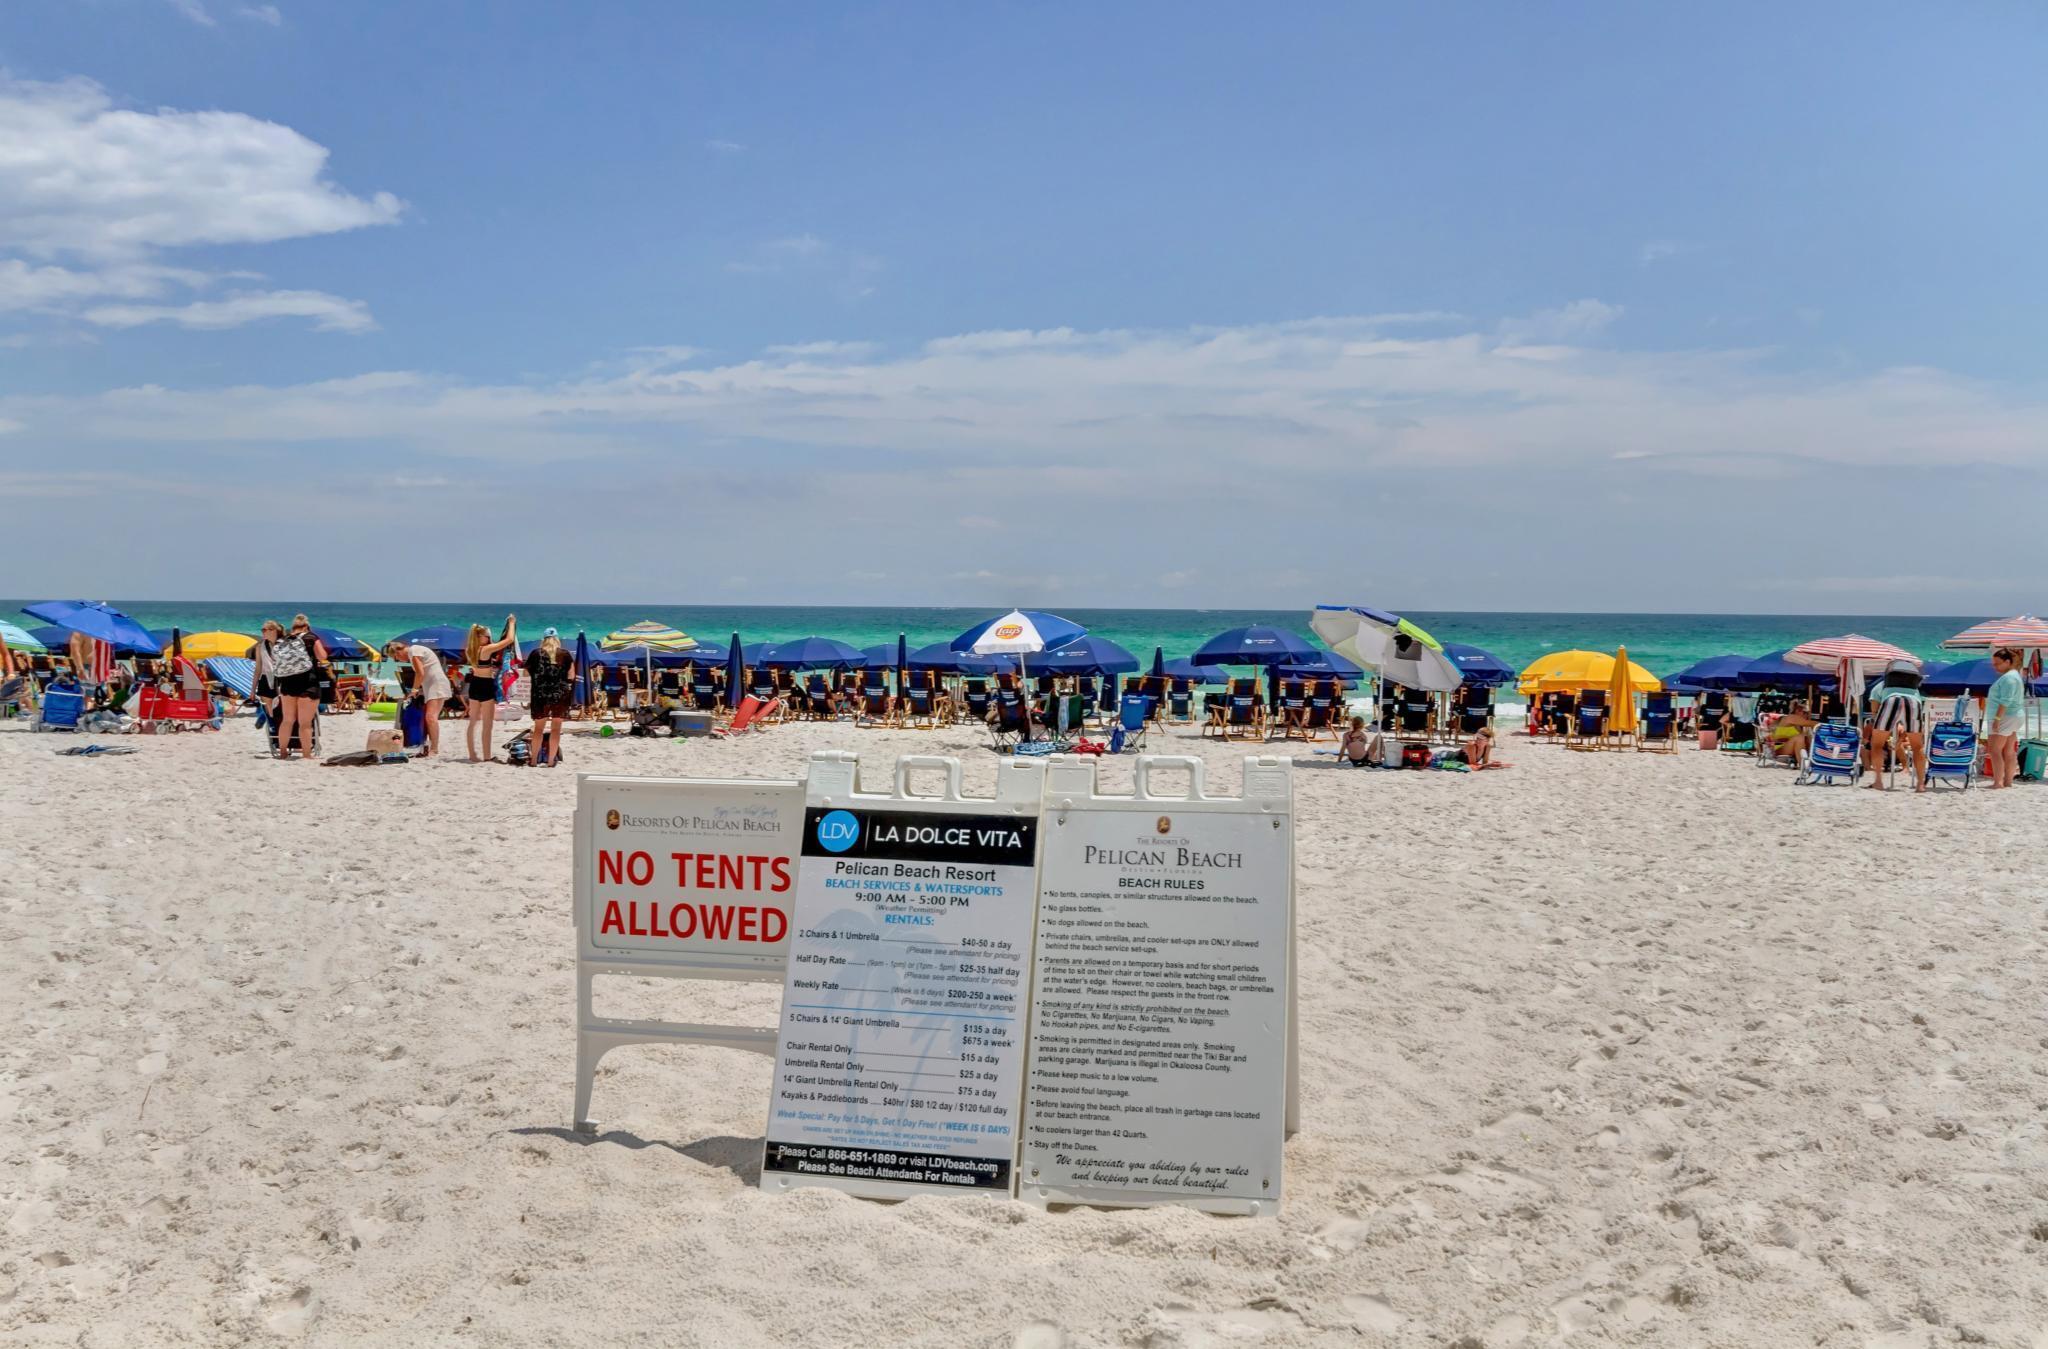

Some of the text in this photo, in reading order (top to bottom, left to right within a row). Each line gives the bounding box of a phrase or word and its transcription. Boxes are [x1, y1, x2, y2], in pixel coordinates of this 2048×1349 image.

[822, 822, 856, 840] LDV
[874, 826, 1021, 848] LA DOLCE VITA
[1084, 846, 1242, 868] PELICAN BEACH
[599, 850, 791, 893] NO TENTS
[835, 862, 996, 881] Pelican Beach Resort
[826, 879, 1003, 896] BEACH SERVICES & WATERSPORTS
[1119, 877, 1205, 890] BEACH RULES
[856, 893, 882, 903] 9:00
[886, 894, 906, 904] AM
[919, 895, 946, 906] 5:00
[950, 897, 969, 906] PM
[601, 900, 788, 942] ALLOWED
[885, 914, 935, 926] RENTALS:
[806, 930, 829, 938] Chairs
[846, 932, 879, 940] Umbrella
[962, 938, 988, 947] $40-50
[998, 940, 1012, 950] day
[796, 955, 811, 963] Half
[813, 955, 827, 965] Day
[830, 956, 846, 964] Rate
[960, 964, 986, 973] $25-35
[1006, 968, 1020, 977] day
[794, 980, 820, 990] Weekly
[948, 990, 983, 1000] $200-250
[797, 1014, 820, 1022] Chairs
[843, 1017, 863, 1026] Giant
[866, 1018, 900, 1028] Umbrella
[963, 1024, 982, 1033] $135
[992, 1026, 1006, 1037] day
[962, 1036, 981, 1045] $675
[787, 1042, 806, 1050] Chair
[809, 1043, 832, 1052] Rental
[834, 1044, 852, 1054] Only
[961, 1053, 975, 1062] $15
[984, 1055, 999, 1065] day
[785, 1058, 818, 1068] Umbrella
[820, 1060, 844, 1069] Rental
[847, 1062, 864, 1072] Only
[960, 1069, 974, 1079] $25
[983, 1072, 998, 1082] day
[796, 1076, 815, 1084] Giant
[818, 1077, 852, 1086] Umbrella
[854, 1080, 878, 1089] Rental
[880, 1081, 898, 1092] Only
[958, 1086, 972, 1096] $75
[982, 1089, 996, 1099] day
[1096, 1088, 1130, 1098] language.
[781, 1091, 808, 1101] Kayaks
[818, 1093, 868, 1104] Paddleboards
[883, 1097, 904, 1107] $40hr
[911, 1099, 924, 1108] $80
[927, 1101, 937, 1109] 1/2
[939, 1102, 952, 1112] day
[960, 1103, 977, 1112] $120
[979, 1104, 991, 1113] full
[994, 1105, 1007, 1116] day
[1073, 1128, 1093, 1136] larger
[1034, 1141, 1049, 1150] Stay
[779, 1145, 998, 1172] Please Call 866-651-1869 or visit LDVbeach.com
[1056, 1154, 1071, 1164] We
[1075, 1159, 1125, 1168] appreciate
[1129, 1162, 1145, 1170] you
[1149, 1160, 1185, 1175] abiding
[1190, 1162, 1201, 1175] by
[1225, 1166, 1248, 1175] rules
[798, 1160, 975, 1184] Please See Beach Attendants For Rentals
[1072, 1171, 1090, 1180] and
[1093, 1171, 1129, 1185] keeping
[1152, 1174, 1179, 1185] beach
